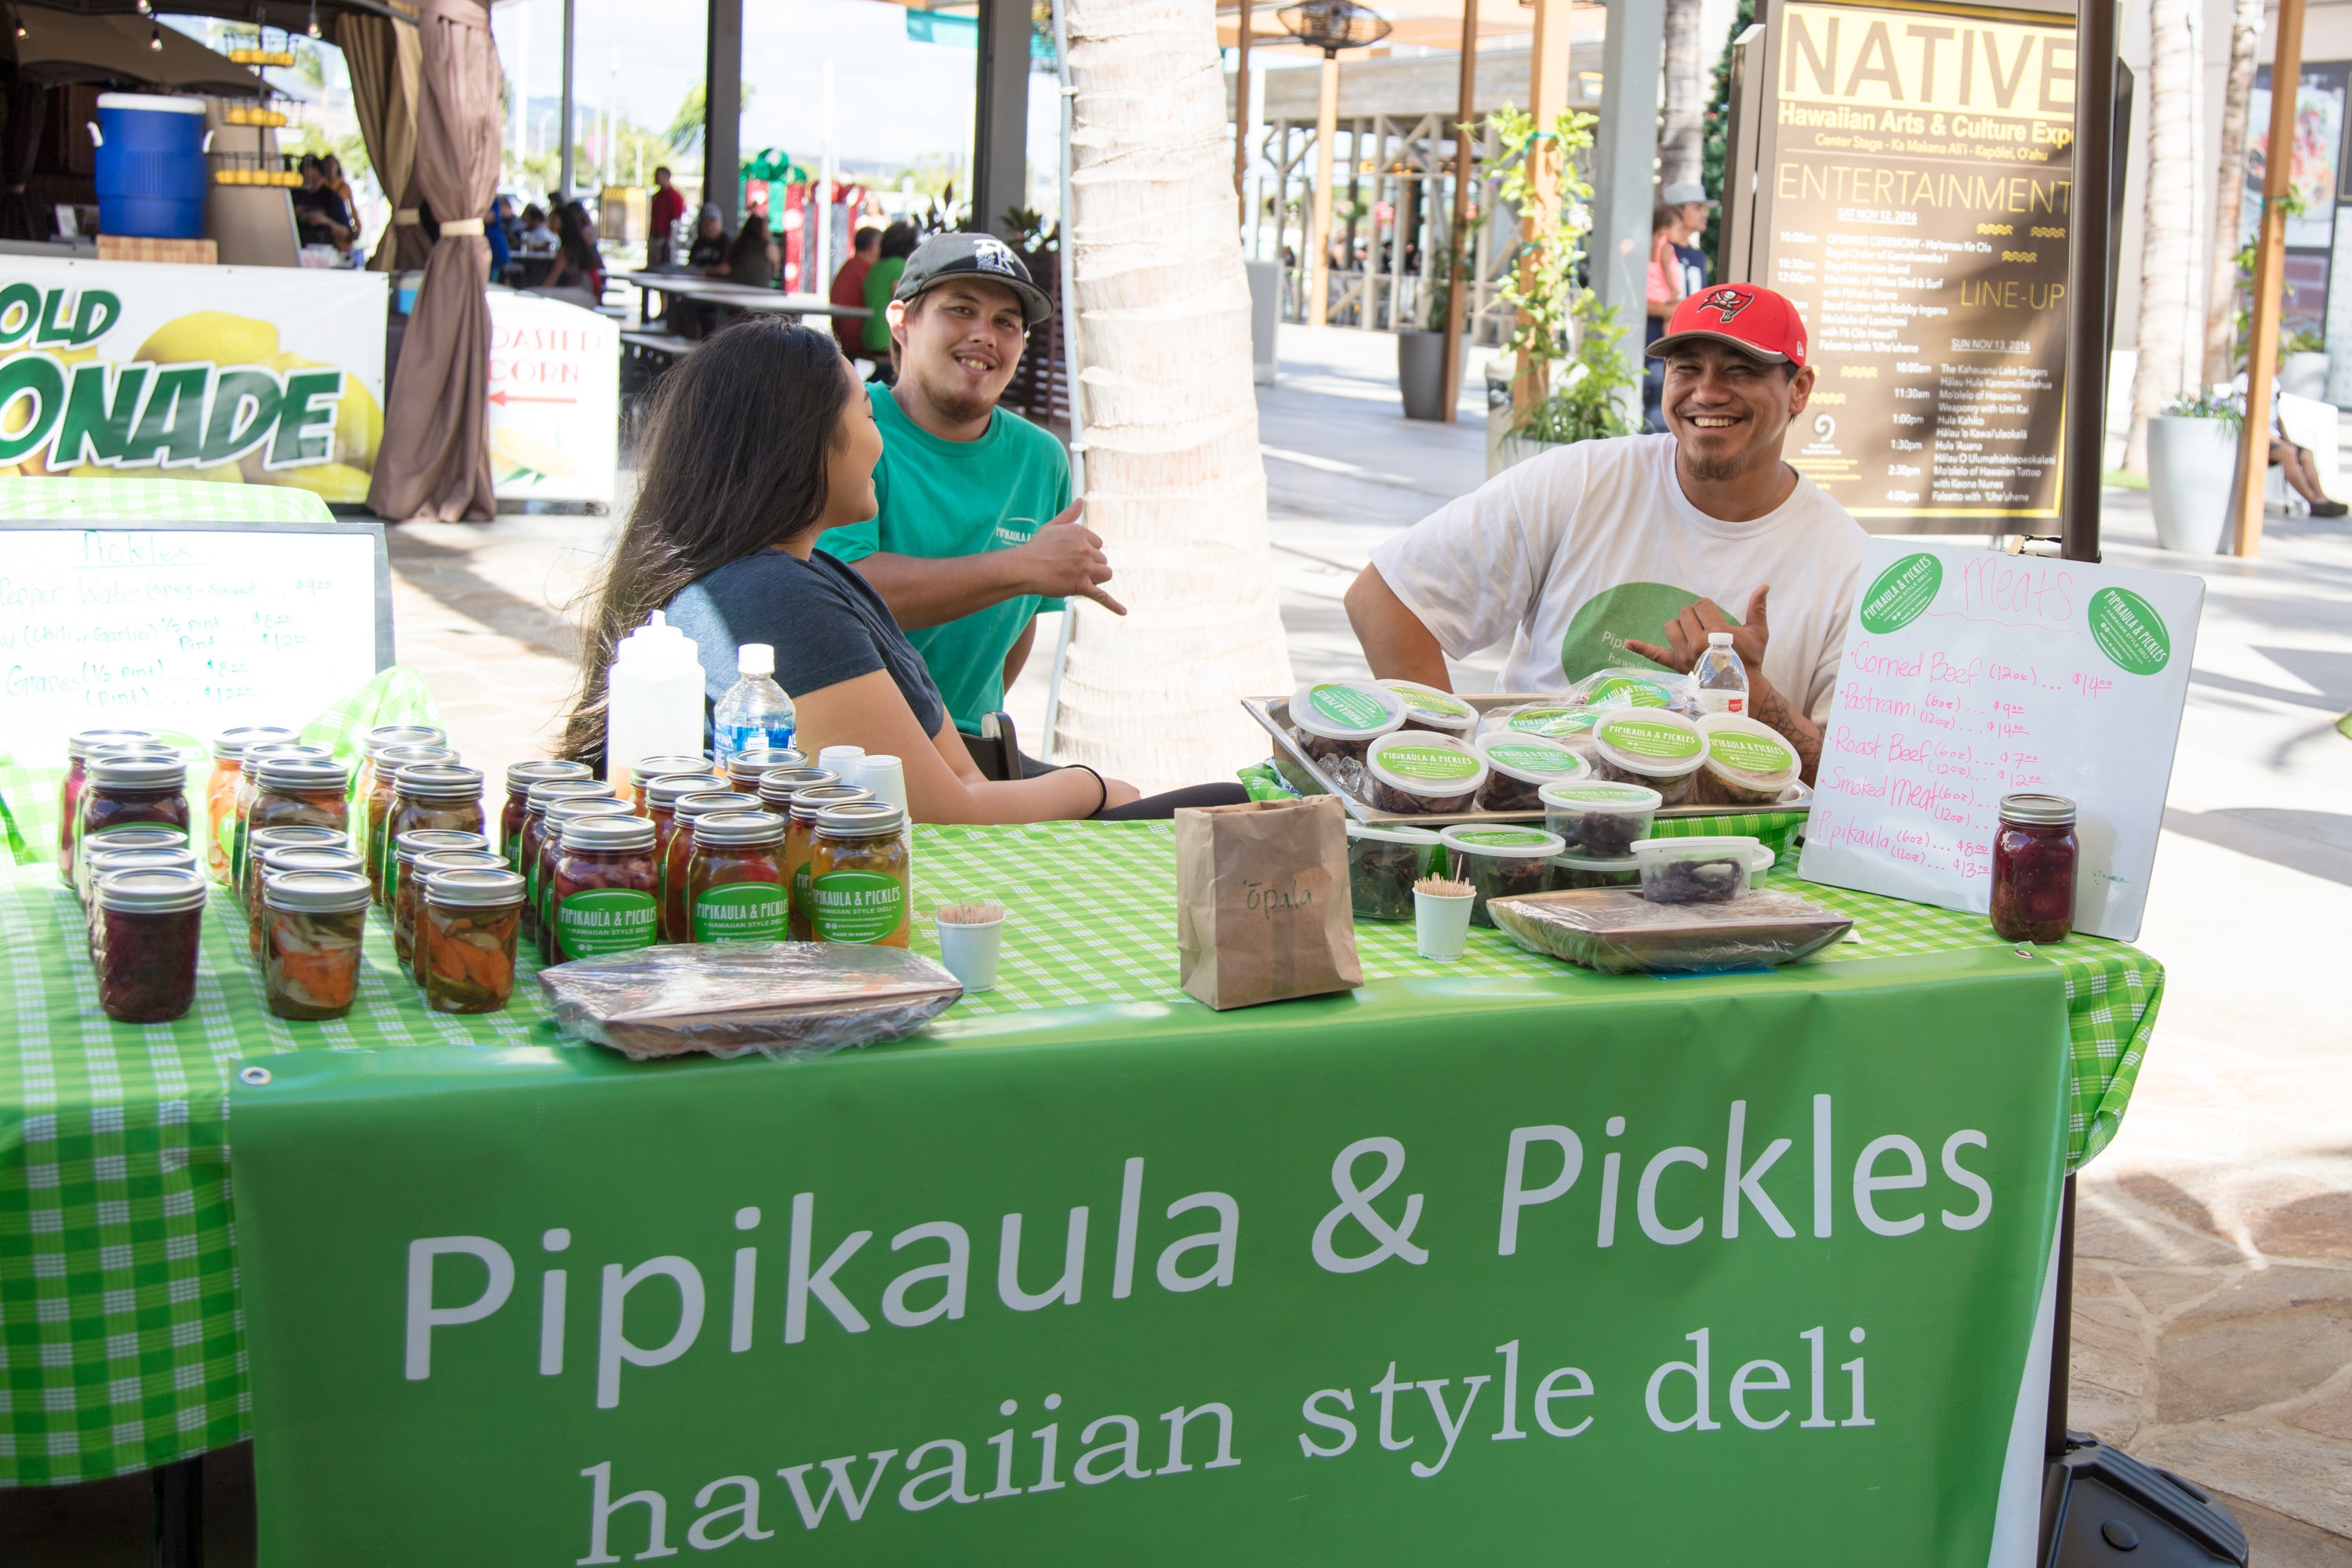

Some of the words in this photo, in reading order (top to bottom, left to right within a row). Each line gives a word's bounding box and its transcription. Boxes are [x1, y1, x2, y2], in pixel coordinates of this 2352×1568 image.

[1784, 13, 2076, 113] NATIVE
[1778, 100, 1876, 131] Hawaiian
[1879, 110, 1926, 135] Arts
[1930, 113, 1947, 136] &
[1951, 114, 2027, 143] Culture
[2031, 121, 2074, 150] Exp
[1815, 132, 1852, 147] Center
[1853, 135, 1884, 152] Stage
[1891, 138, 1905, 151] Ka
[1906, 140, 1947, 154] Makana
[1778, 163, 2071, 214] ENTERTAINMENT
[1838, 207, 1855, 219] SAT
[1856, 209, 1878, 220] NOV
[1895, 211, 1918, 223] 2016
[1961, 280, 2065, 310] LINE-UP
[1951, 338, 1970, 348] SUN
[1972, 339, 1992, 349] NOV
[2009, 340, 2031, 350] 2016
[1941, 364, 1956, 373] The
[1998, 366, 2017, 376] Lake
[2019, 366, 2049, 379] Singers
[1965, 378, 1984, 387] Hula
[1895, 388, 1930, 398] 11:30am
[1975, 390, 1985, 400] of
[1986, 390, 2021, 401] Hawaiian
[1939, 402, 1980, 416] Weaponry
[1980, 403, 1998, 413] with
[1999, 404, 2016, 414] Umi
[2016, 405, 2029, 414] Kai
[1893, 414, 1924, 426] 1:00pm
[1937, 414, 1956, 424] Hula
[1958, 416, 1985, 426] Kahiko
[1890, 439, 1922, 452] 1:30pm
[1935, 441, 1955, 451] Hula
[1933, 478, 1950, 488] with
[1951, 479, 1977, 488] Keone
[1978, 479, 2004, 489] Nunes
[1969, 466, 1979, 476] of
[1980, 466, 2015, 477] Hawaiian
[2016, 466, 2041, 477] Tattoo
[1932, 491, 1963, 501] Falsetto
[1965, 492, 1981, 501] with
[82, 530, 192, 564] Pickles
[77, 576, 140, 607] Water
[1864, 585, 1900, 620] PIPIKAULA
[1896, 579, 1906, 590] &
[1902, 556, 1931, 584] PICKLES
[1880, 595, 1904, 617] HAWAIIAN
[1903, 583, 1918, 596] STYLE
[1917, 572, 1929, 583] DELI
[1964, 557, 2073, 621] Meats
[2104, 590, 2139, 630] PIPIKAULA
[2132, 625, 2144, 636] &
[2138, 631, 2167, 662] PICKLES
[2106, 609, 2128, 633] HAWAIIAN
[2126, 632, 2140, 648] STYLE
[2138, 648, 2149, 659] DELI
[1854, 641, 1924, 678] Corned
[1930, 652, 1982, 686] Beef
[6, 665, 83, 697] Grapes
[1845, 682, 1918, 716] Pastrami
[1610, 725, 1652, 738] PIPIKAULA
[1663, 733, 1696, 744] PICKLES
[1836, 725, 1883, 759] Roast
[1889, 733, 1931, 765] Beef
[1383, 752, 1428, 761] PIPIKAULA
[1439, 756, 1472, 765] PICKLES
[1824, 766, 1888, 797] Smoked
[1819, 810, 1889, 850] Pipikaula
[855, 891, 862, 906] &
[866, 886, 901, 906] PICKLES
[561, 907, 610, 927] PIPIKAULA
[614, 911, 622, 927] &
[625, 906, 657, 926] PICKLES
[696, 903, 746, 920] PIPIKAULA
[750, 904, 758, 919] &
[405, 1157, 1239, 1409] Pipikaula
[1312, 1137, 1428, 1273] &
[1498, 1094, 1993, 1256] Pickles
[576, 1403, 1241, 1566] hawaiian
[1299, 1340, 1594, 1477] style
[1645, 1327, 1875, 1438] deli
